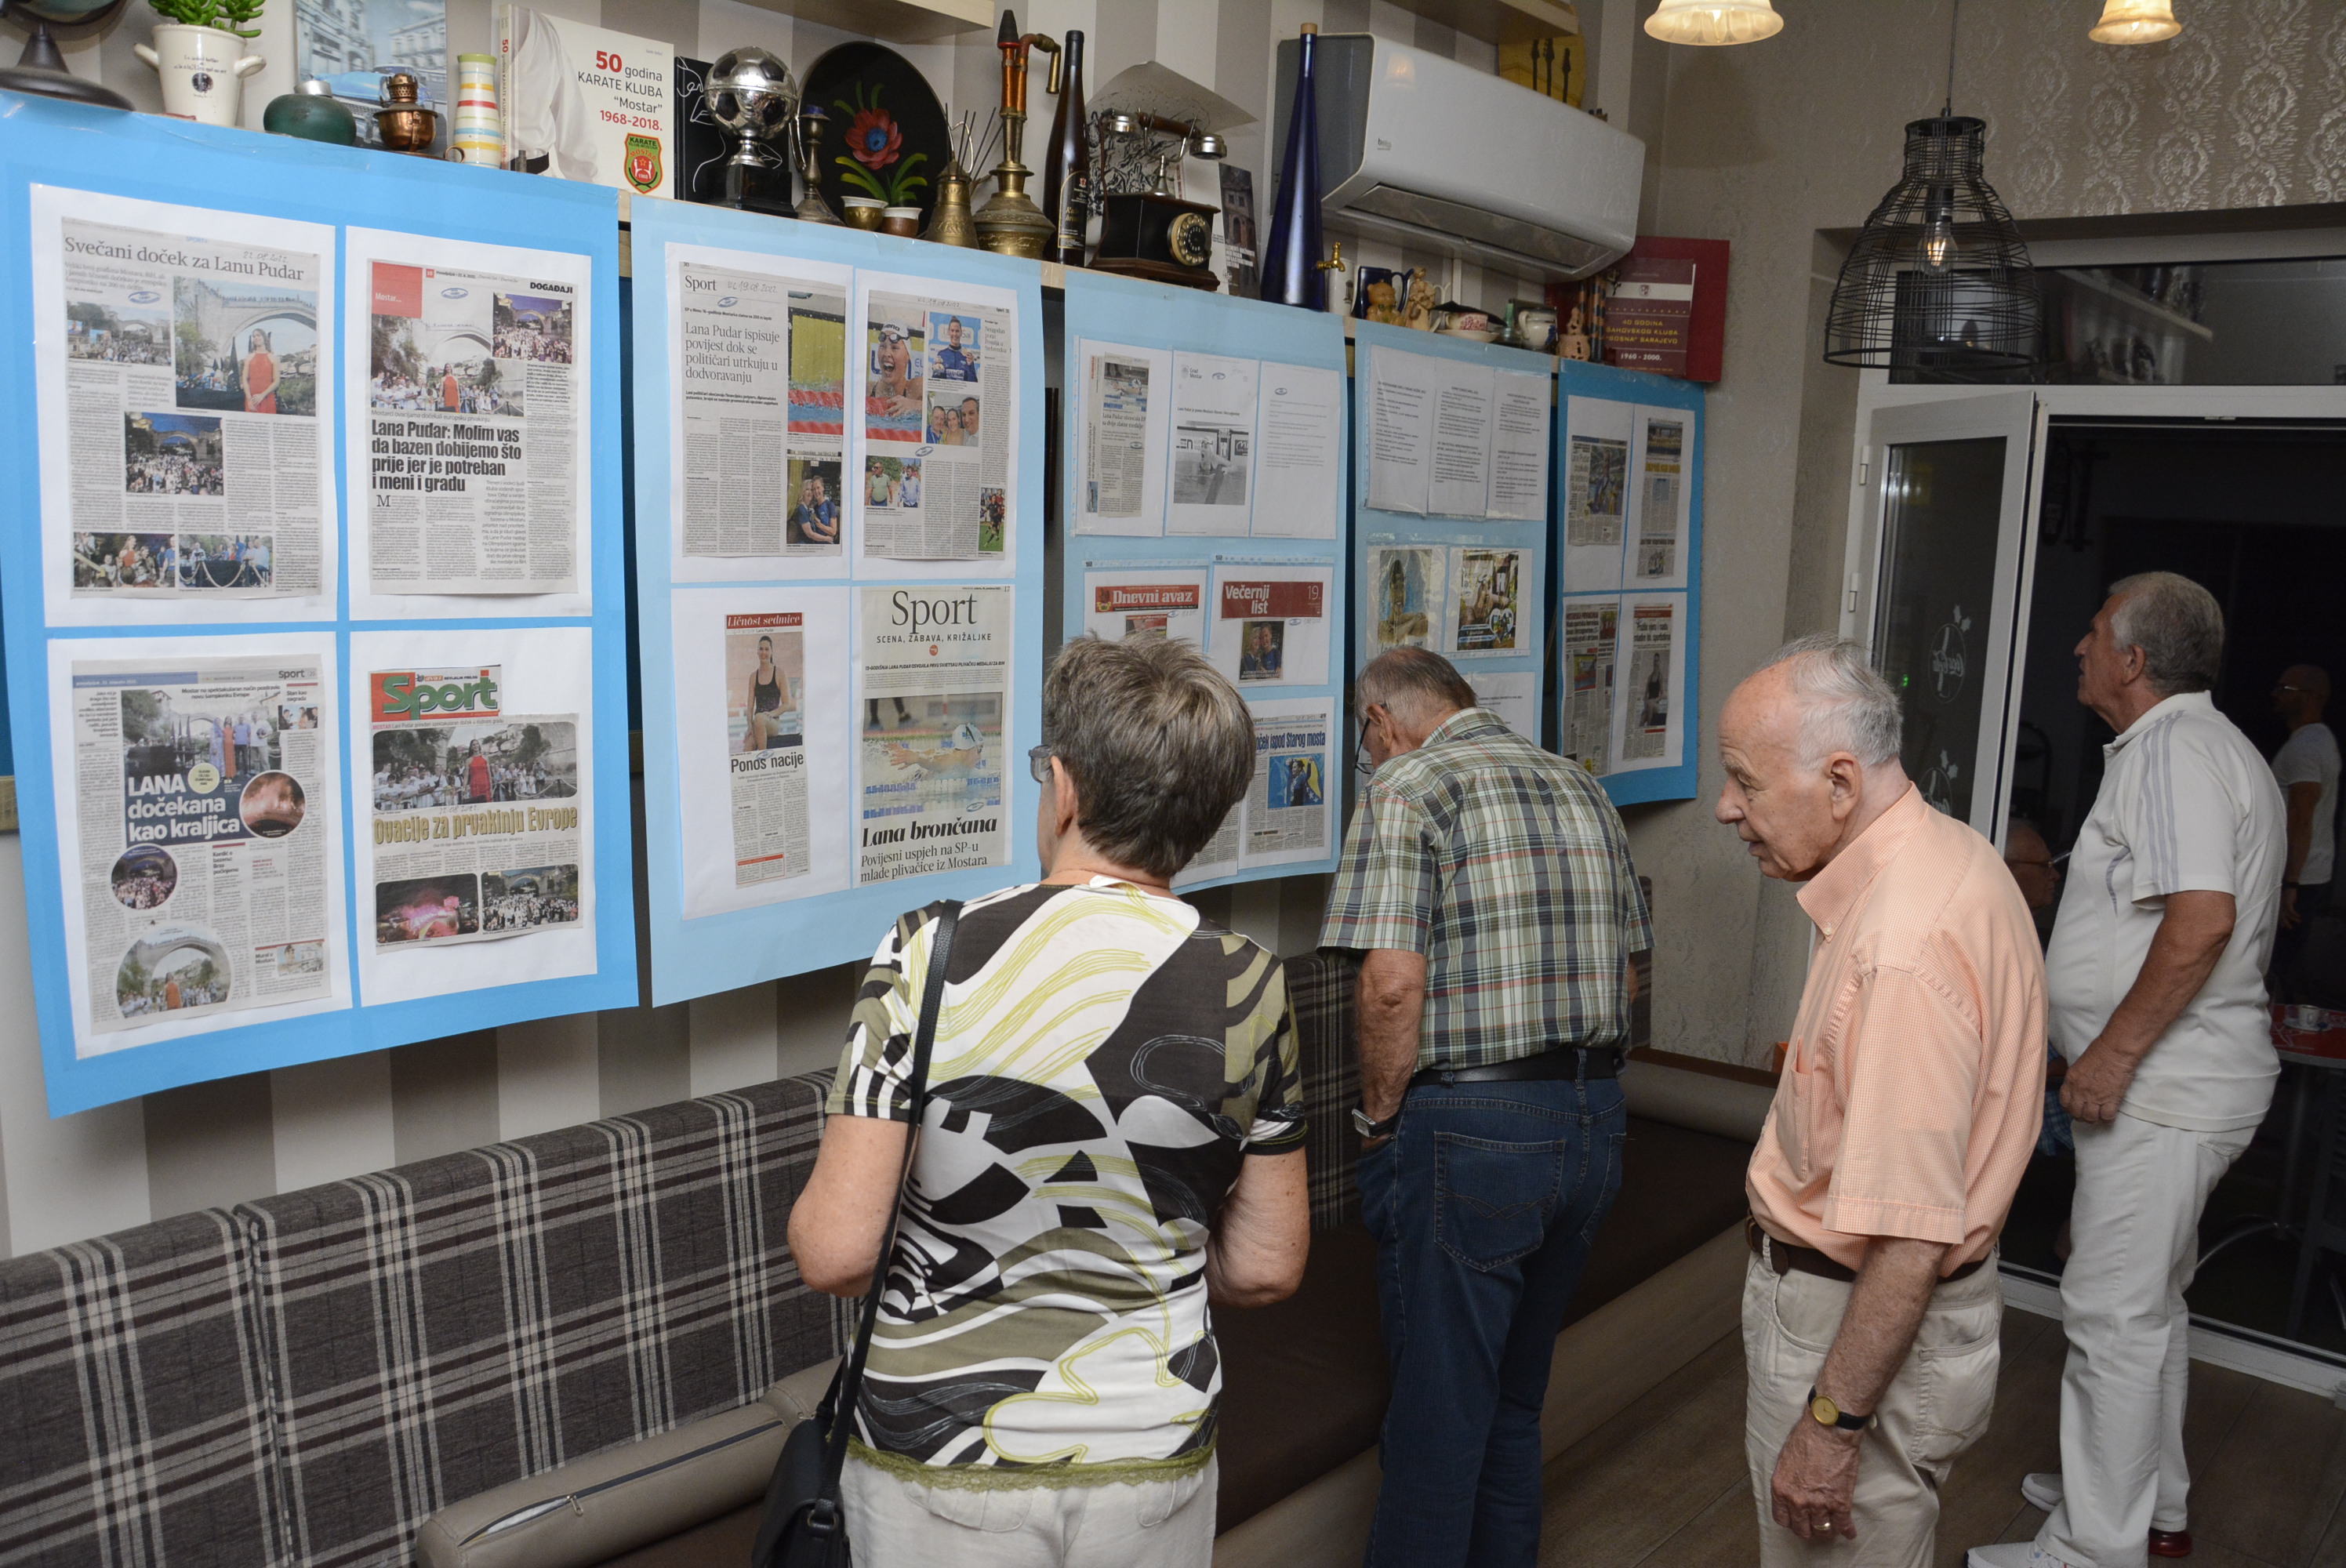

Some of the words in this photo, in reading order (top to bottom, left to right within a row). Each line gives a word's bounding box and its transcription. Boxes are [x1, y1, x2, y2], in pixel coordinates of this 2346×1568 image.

[596, 50, 622, 72] 50
[625, 66, 663, 82] godina
[578, 71, 621, 90] KARATE
[626, 82, 663, 98] KLUBA
[600, 111, 663, 131] 1968-2018.
[630, 137, 657, 146] KARATE
[65, 237, 132, 260] Svečani
[136, 247, 188, 267] doček
[193, 256, 210, 270] za
[215, 256, 254, 275] Lanu
[259, 262, 304, 281] Pudar
[530, 282, 572, 294] DOGAĐAJI
[685, 275, 717, 292] Sport
[685, 322, 710, 336] Lana
[713, 325, 742, 339] Pudar
[745, 328, 780, 344] ispisuje
[1606, 325, 1652, 334] ŠAHOVSKOG
[685, 339, 724, 353] povijest
[726, 341, 745, 354] dok
[747, 345, 757, 354] se
[685, 353, 730, 368] političari
[732, 356, 768, 372] utrkuju
[772, 362, 778, 371] u
[685, 367, 752, 383] dodvoravanju
[372, 419, 405, 438] Lana
[408, 421, 452, 440] Pudar:
[453, 424, 494, 442] Molim
[496, 429, 519, 443] vas
[372, 438, 389, 454] da
[392, 439, 433, 456] bazen
[436, 441, 499, 459] dobijemo
[502, 443, 521, 459] što
[372, 456, 404, 474] prije
[407, 458, 427, 474] jer
[428, 460, 442, 475] je
[445, 459, 506, 476] potreban
[372, 475, 376, 489] i
[380, 474, 416, 491] meni
[417, 476, 421, 491] i
[424, 476, 466, 492] gradu
[1113, 590, 1159, 604] Dnevni
[1162, 592, 1193, 602] avaz
[1226, 585, 1270, 601] Večernji
[892, 590, 978, 634] Sport
[1251, 601, 1269, 614] list
[728, 615, 761, 626] Ličnost
[764, 614, 800, 625] sedmice
[877, 634, 906, 644] SCENA,
[909, 633, 944, 643] ZABAVA,
[947, 632, 992, 641] KRIŽALJKE
[278, 669, 305, 680] sport
[383, 670, 498, 720] Sport
[1256, 733, 1269, 750] oček
[1269, 733, 1285, 750] ispod
[1287, 731, 1306, 748] Starog
[1307, 731, 1325, 747] mosta
[731, 758, 766, 773] Ponos
[771, 752, 804, 768] nacije
[129, 775, 186, 796] LANA
[129, 797, 225, 818] dočekana
[129, 822, 167, 842] kao
[172, 818, 240, 840] kraljica
[374, 815, 429, 844] Ovacije
[433, 817, 449, 838] za
[453, 810, 524, 839] prvakinju
[528, 807, 578, 832] Evrope
[862, 827, 905, 848] Lana
[910, 817, 997, 840] brončana
[862, 850, 902, 867] Povijesni
[905, 846, 937, 862] uspjeh
[941, 846, 952, 855] na
[955, 842, 979, 854] SP-u
[861, 868, 890, 882] mlade
[892, 862, 934, 880] plivačice
[936, 860, 945, 869] iz
[947, 856, 987, 869] Mostara
